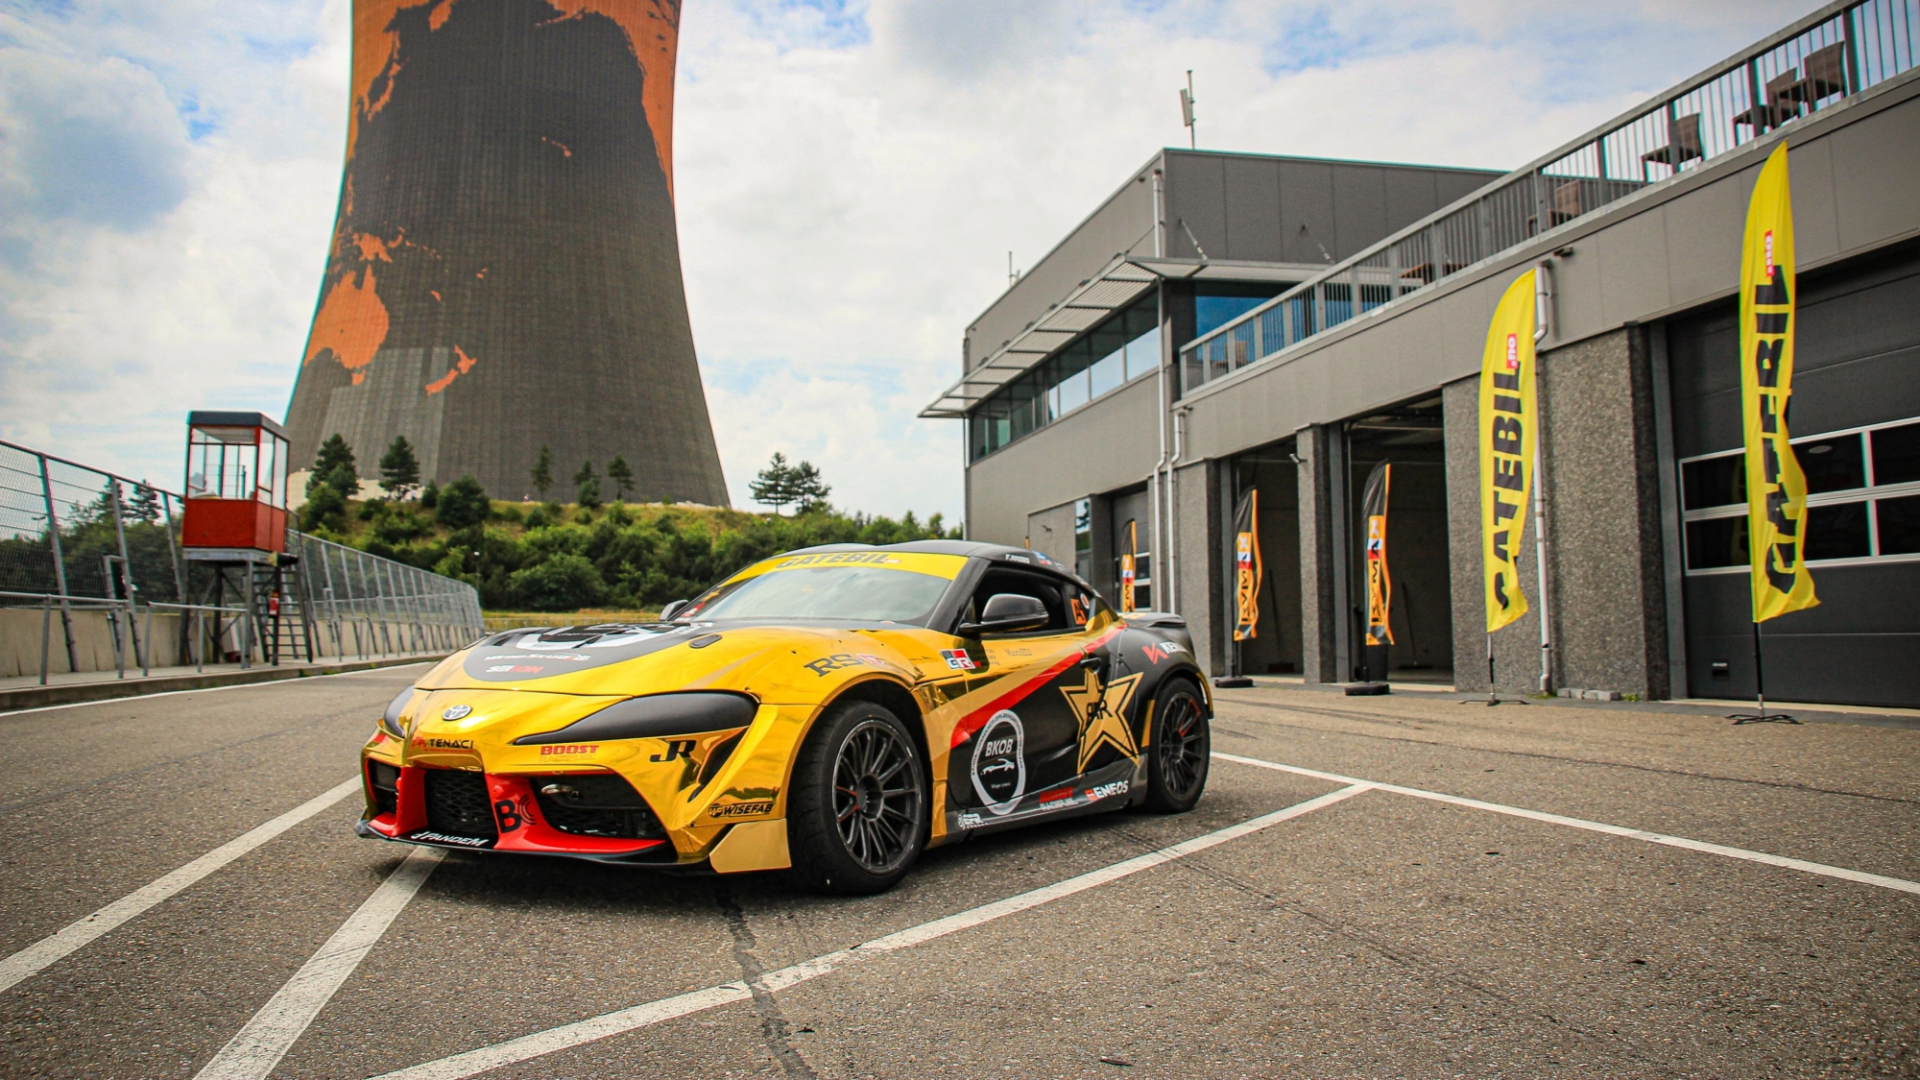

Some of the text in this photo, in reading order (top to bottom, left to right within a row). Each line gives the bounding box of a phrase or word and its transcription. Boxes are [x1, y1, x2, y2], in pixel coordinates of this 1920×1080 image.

[776, 553, 889, 569] GATEBIL
[429, 738, 474, 749] TENACI
[540, 745, 600, 756] BOOST
[649, 739, 697, 763] JR
[985, 739, 1014, 757] BKOB
[1092, 780, 1129, 799] ENEOS
[722, 803, 774, 815] WISEFAB
